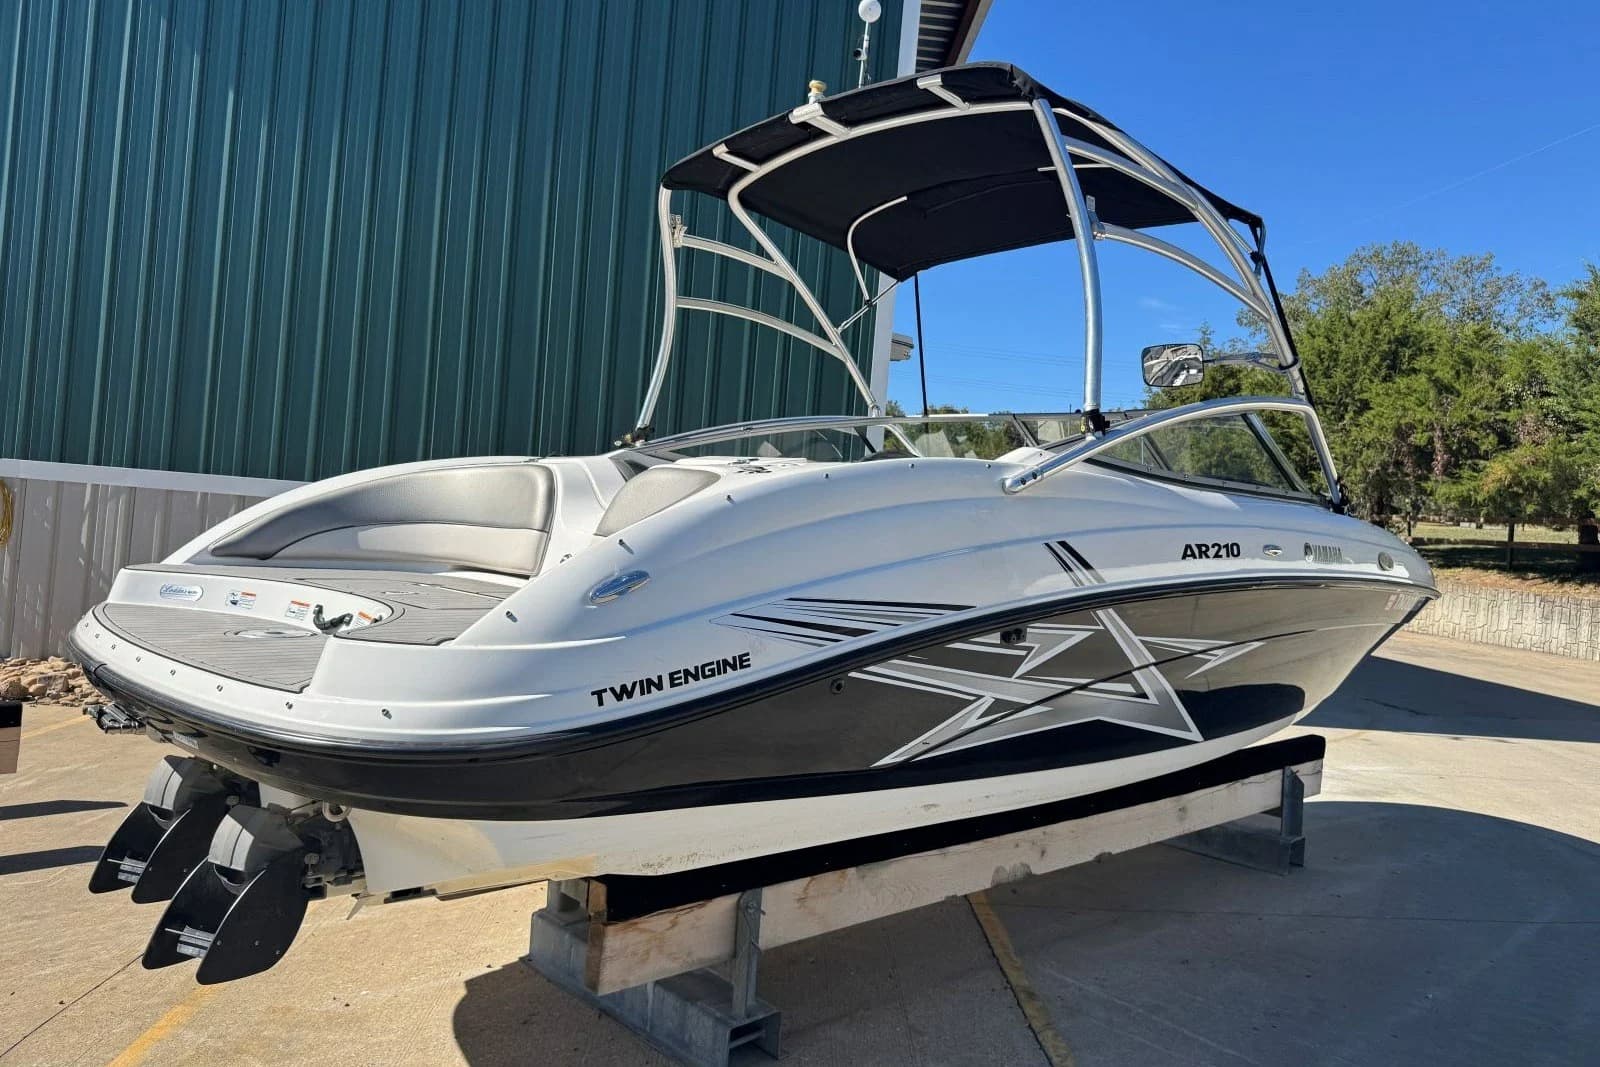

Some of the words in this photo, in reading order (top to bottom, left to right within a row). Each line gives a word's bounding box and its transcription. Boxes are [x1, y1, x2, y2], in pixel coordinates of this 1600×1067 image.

[1181, 542, 1241, 560] AR210
[591, 674, 664, 707] TWIN
[668, 652, 751, 689] ENGINE
